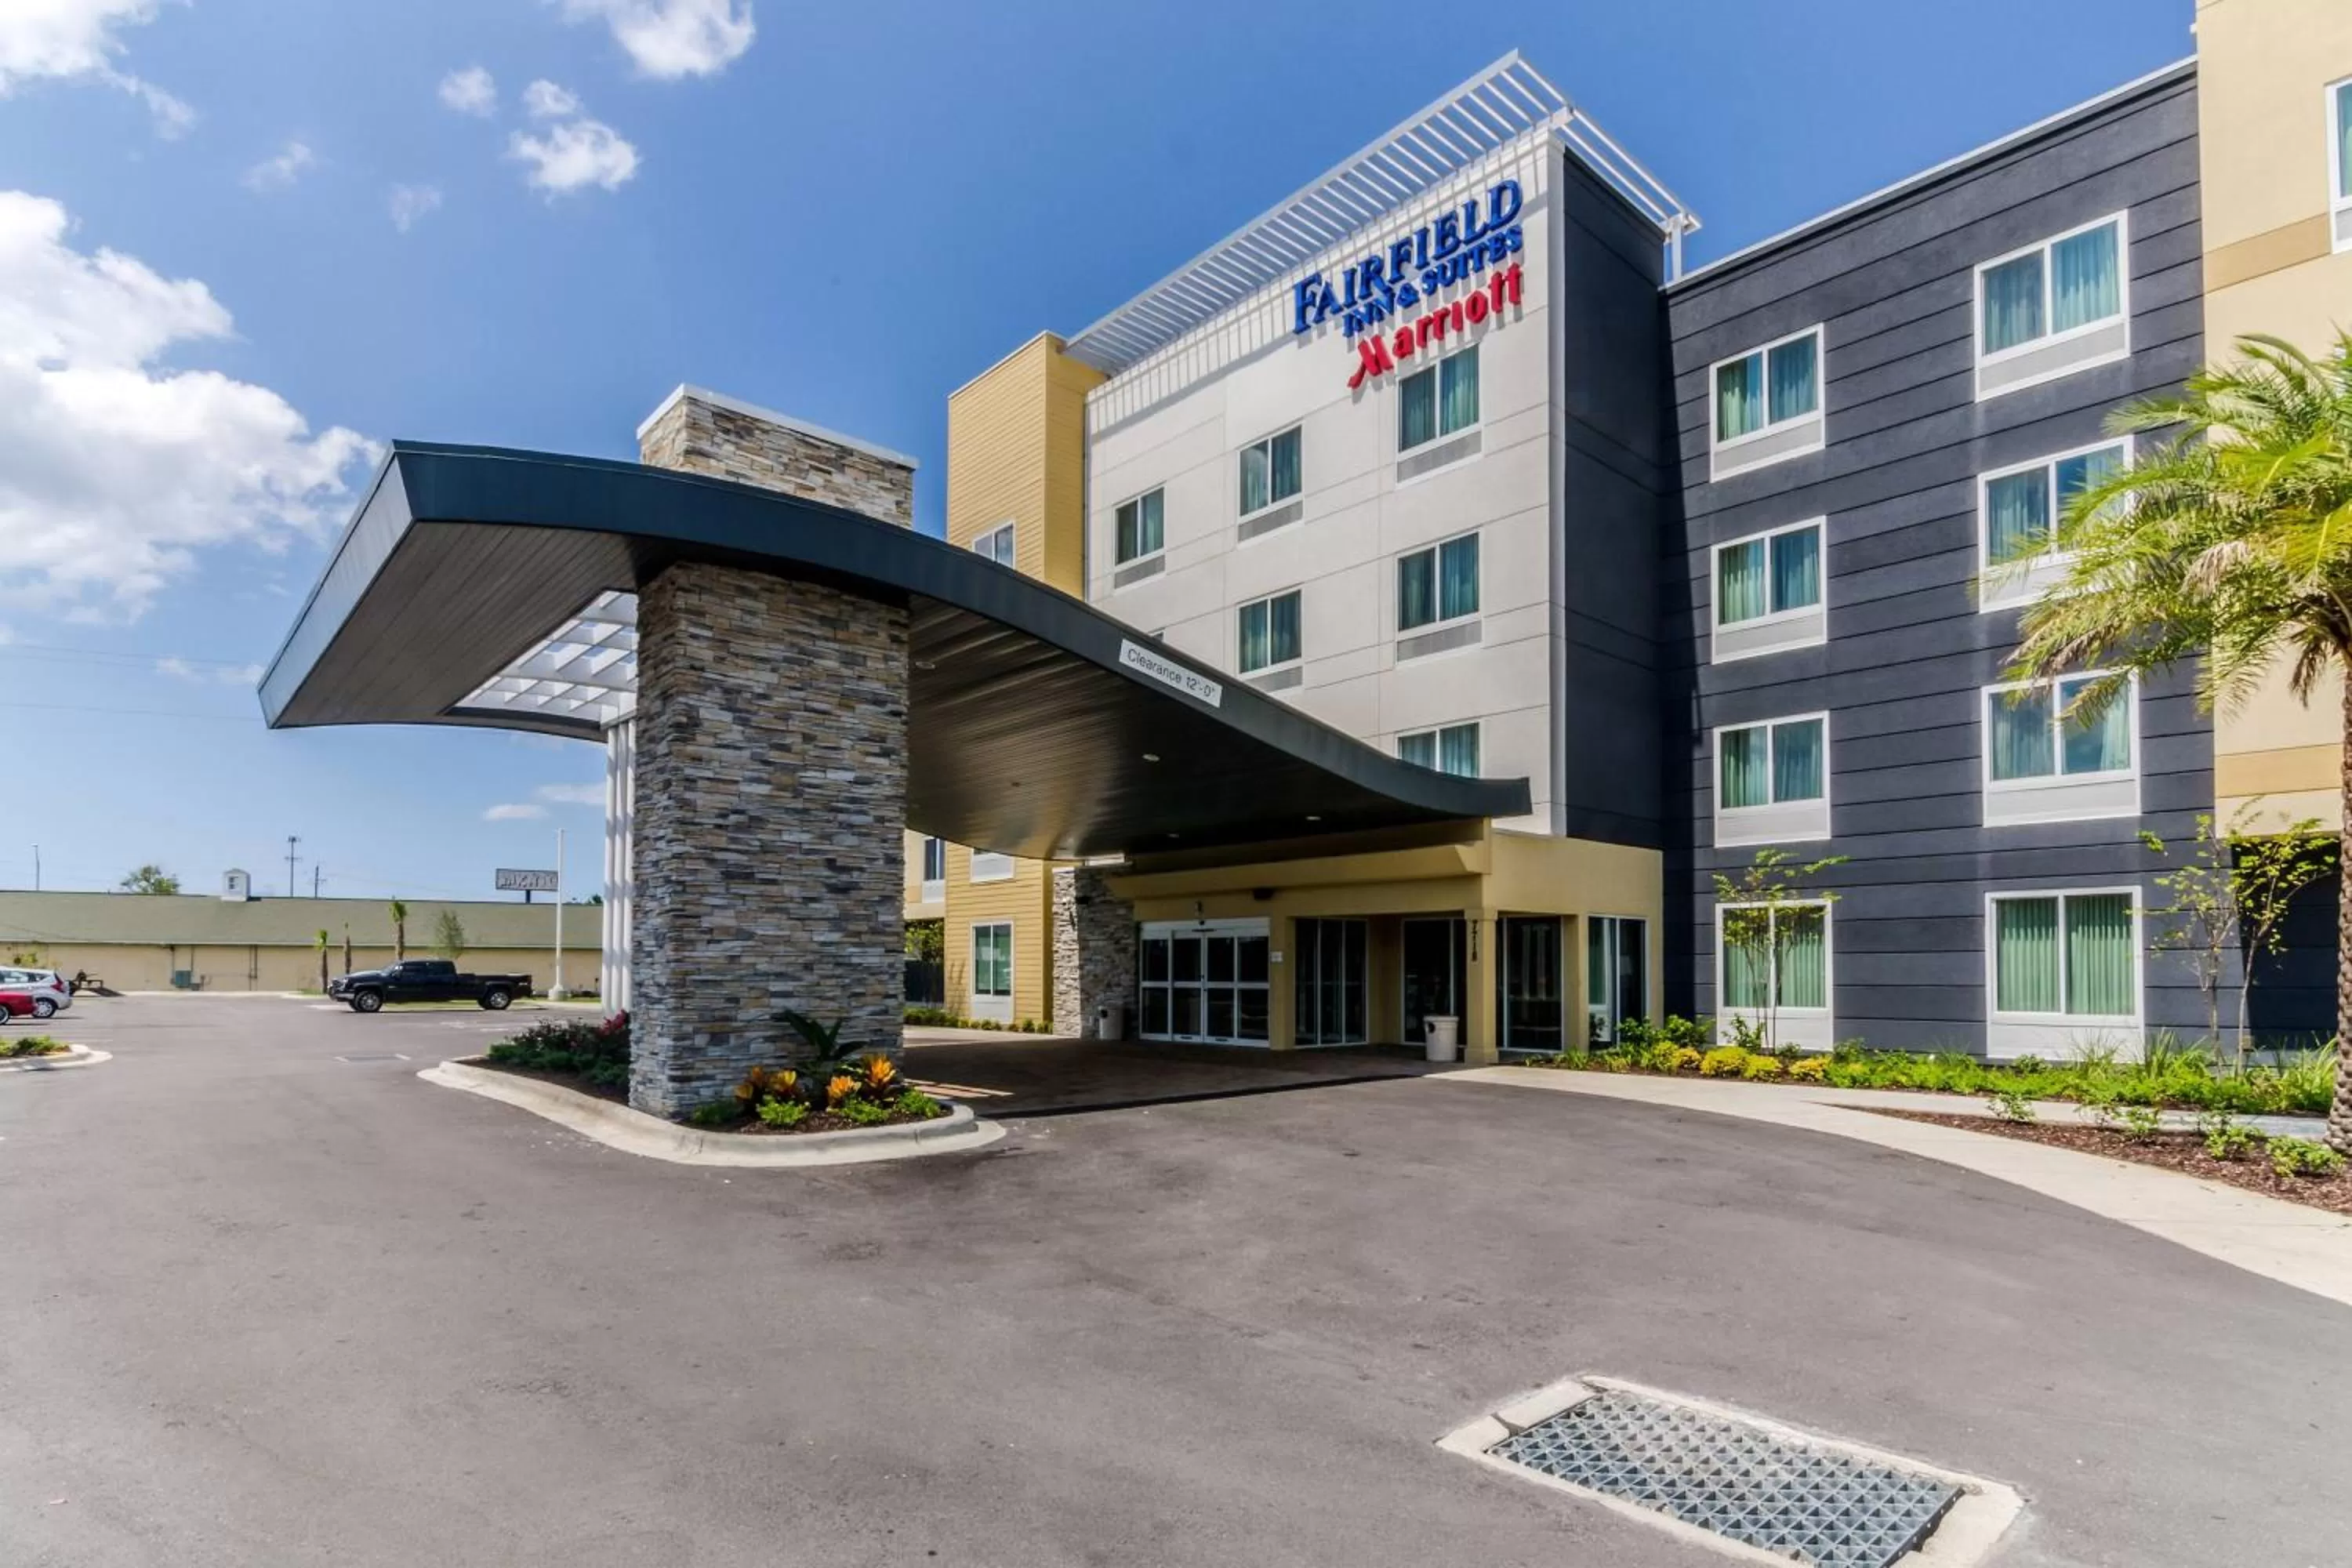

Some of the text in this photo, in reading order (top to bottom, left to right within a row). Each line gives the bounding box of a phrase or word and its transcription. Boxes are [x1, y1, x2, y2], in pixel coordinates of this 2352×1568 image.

[1294, 180, 1523, 335] FAIRFIELD
[1342, 224, 1523, 338] INN & SUITES
[1348, 262, 1523, 389] Marriott
[1127, 648, 1182, 684] Clearance
